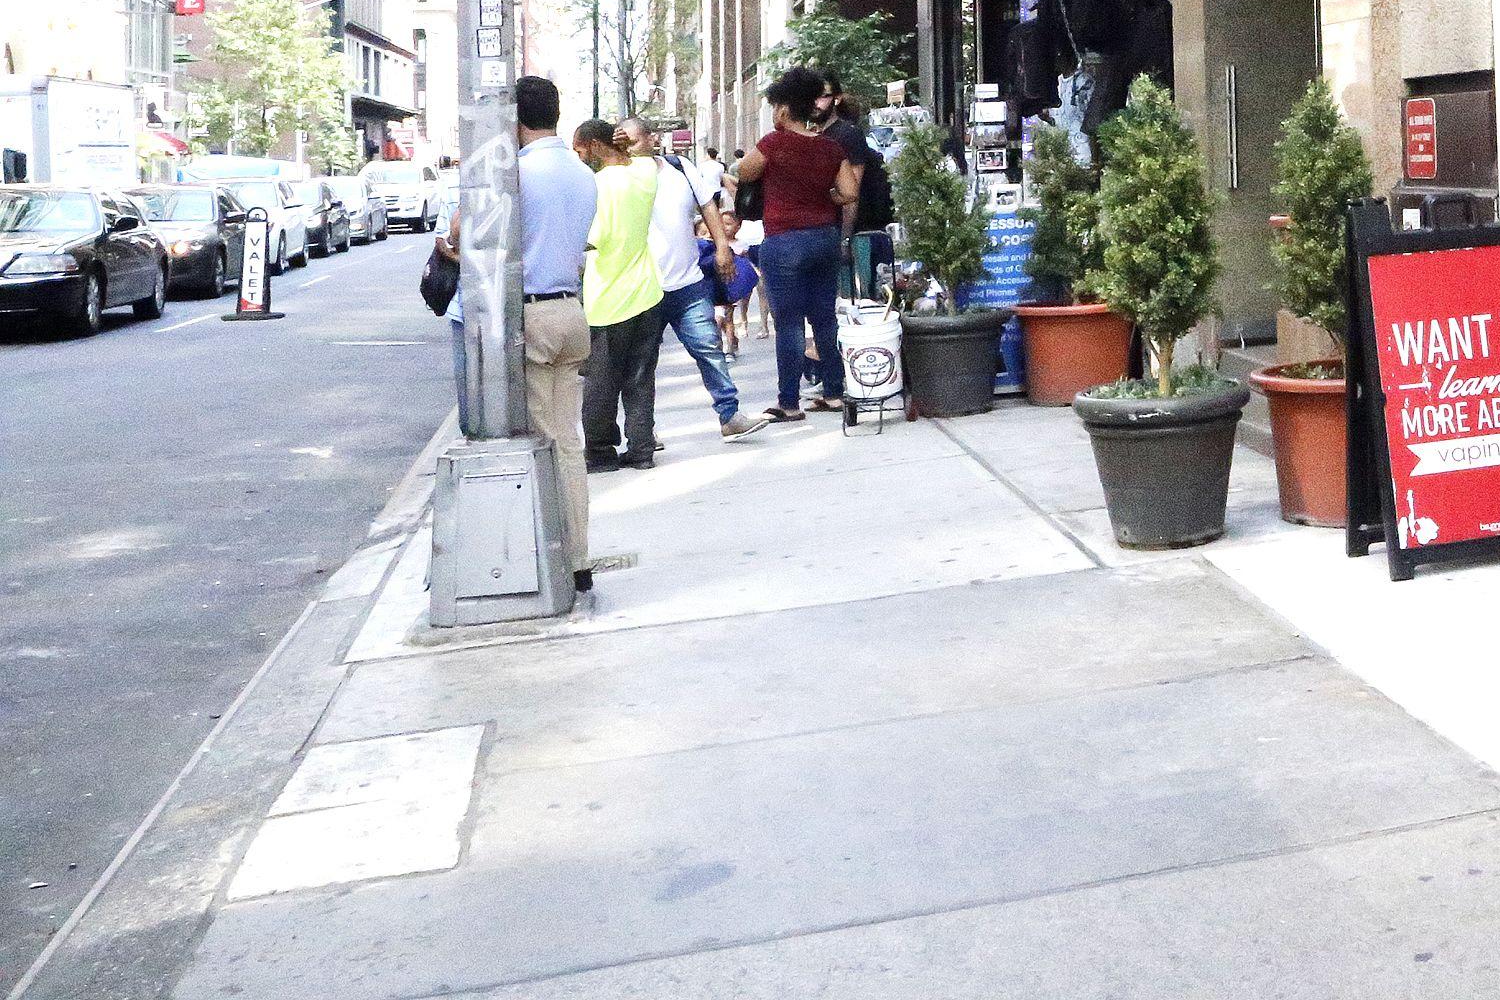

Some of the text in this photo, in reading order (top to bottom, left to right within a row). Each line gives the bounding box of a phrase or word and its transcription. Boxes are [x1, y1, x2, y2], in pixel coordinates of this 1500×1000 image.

[248, 237, 261, 301] VALET
[1391, 313, 1492, 367] WANT
[1401, 401, 1470, 440] MORE
